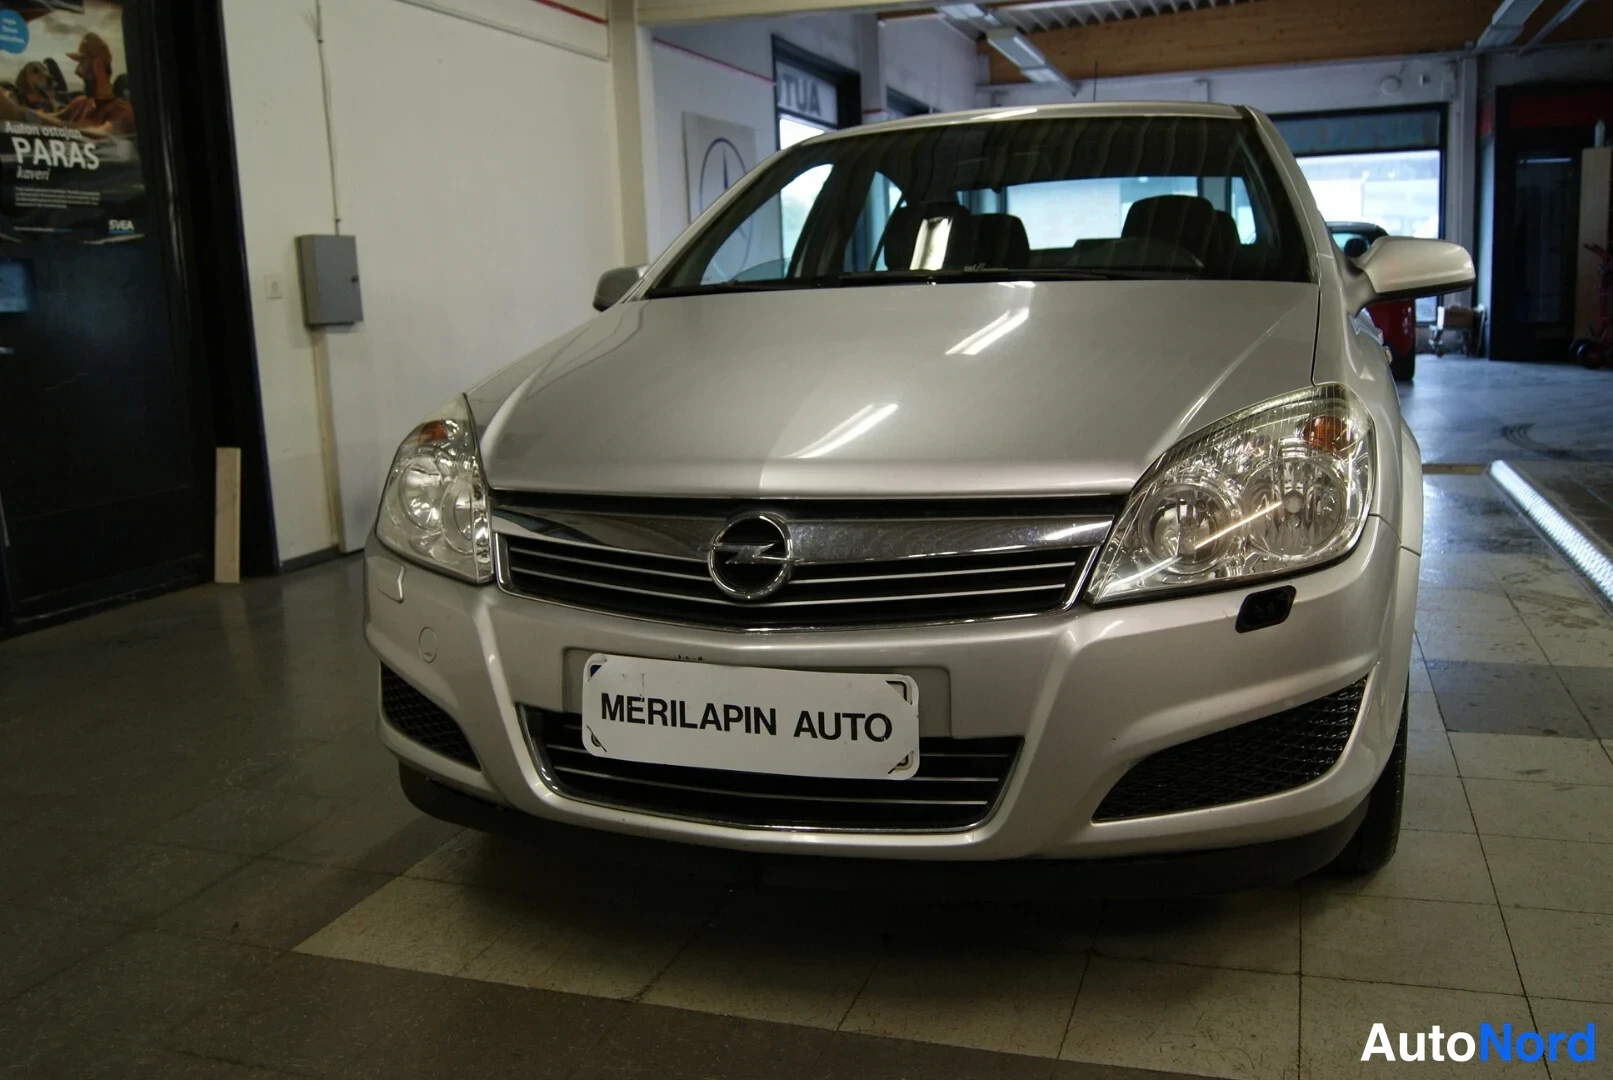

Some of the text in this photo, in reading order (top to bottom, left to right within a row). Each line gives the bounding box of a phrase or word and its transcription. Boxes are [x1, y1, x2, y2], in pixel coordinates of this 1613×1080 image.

[5, 121, 40, 136] Auton
[12, 138, 100, 170] PARAS
[16, 166, 51, 181] kaveri
[601, 693, 893, 742] MERILAPIN AUTO
